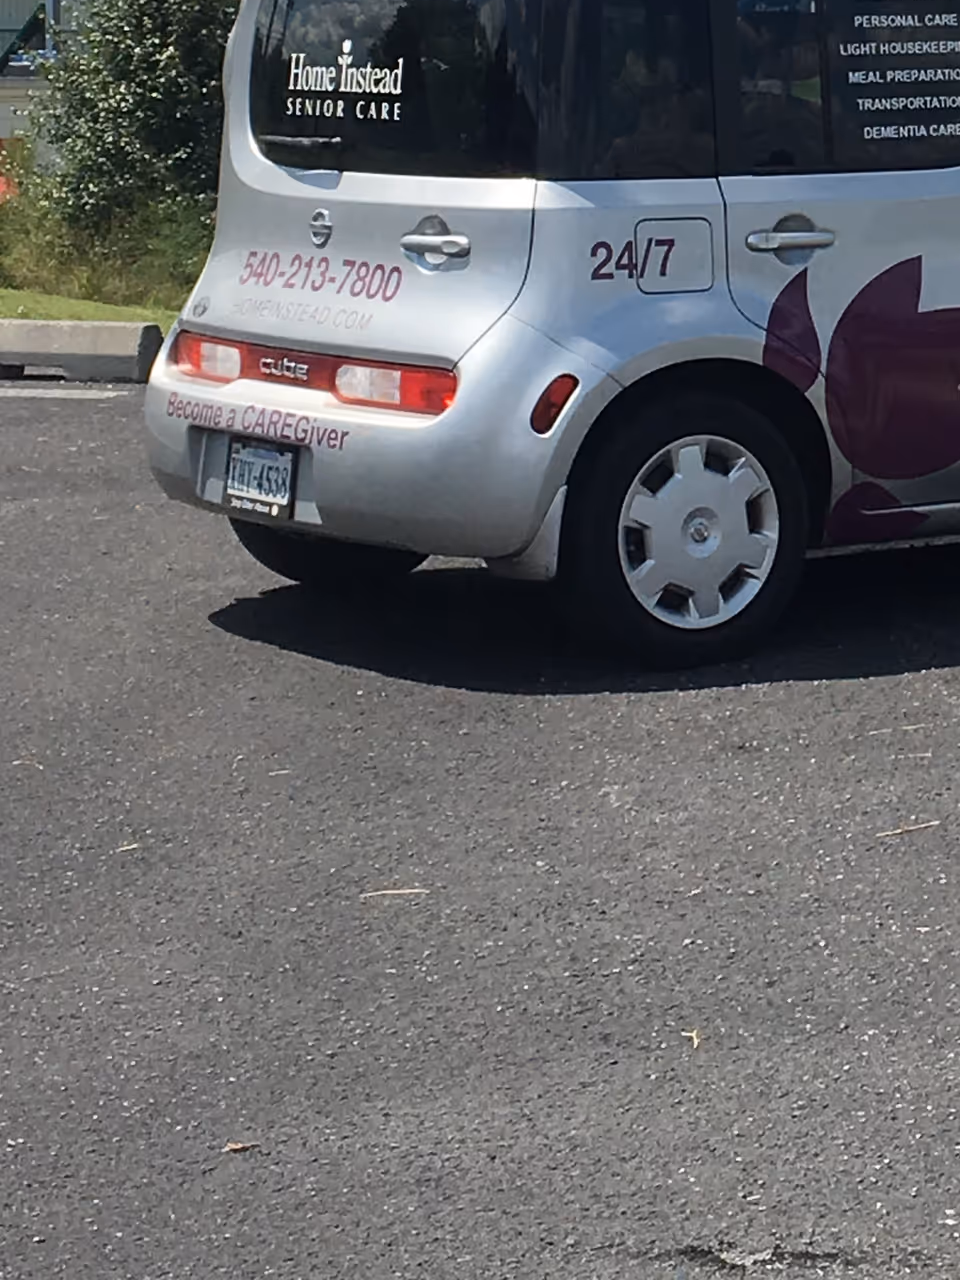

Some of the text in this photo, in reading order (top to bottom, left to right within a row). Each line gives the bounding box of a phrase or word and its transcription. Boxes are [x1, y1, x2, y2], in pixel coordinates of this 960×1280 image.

[854, 14, 958, 28] PERSONAL CARE
[839, 43, 877, 56] LIGHT
[288, 53, 403, 95] Home Instead
[849, 71, 884, 84] MEAL
[286, 97, 401, 121] SENIOR CARE
[864, 125, 928, 139] DEMENTIA
[590, 237, 675, 281] 24/7
[239, 250, 403, 302] 540-213-7800
[233, 298, 374, 330] OMEINSTEADCOM
[167, 392, 350, 451] Become a CAREGiver
